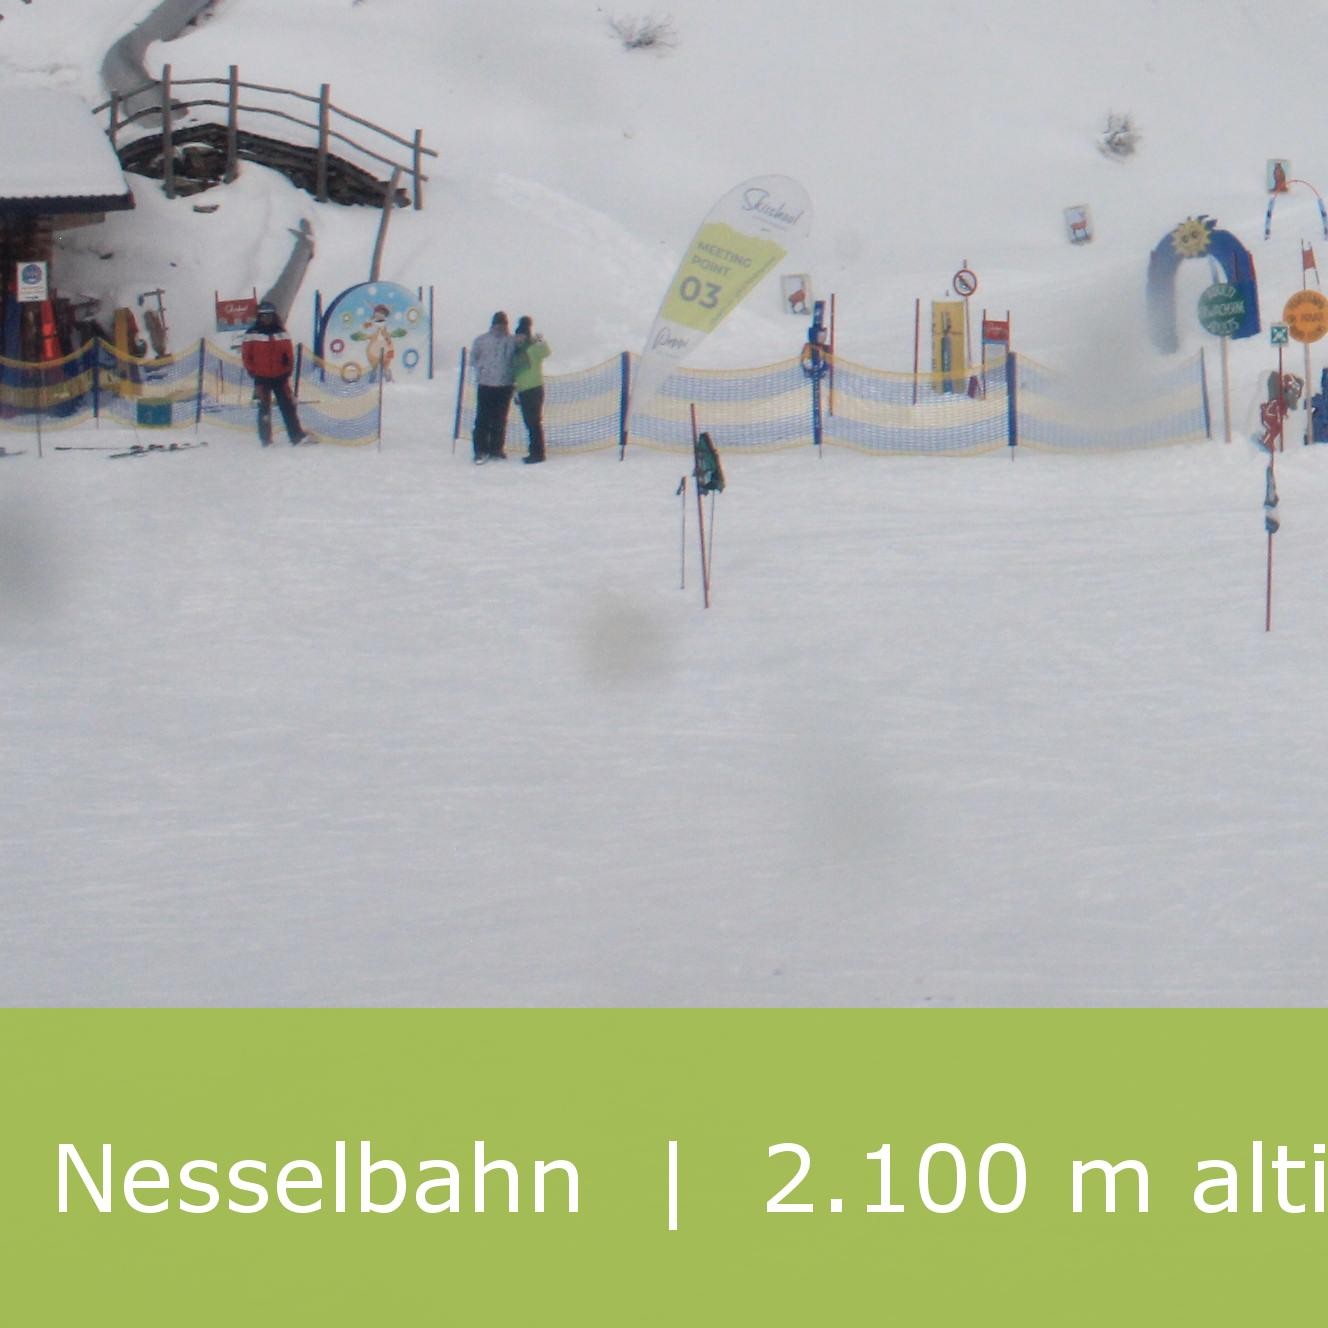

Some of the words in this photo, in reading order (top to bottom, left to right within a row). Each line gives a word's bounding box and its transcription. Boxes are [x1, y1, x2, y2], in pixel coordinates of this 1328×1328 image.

[692, 254, 731, 276] POINT
[697, 241, 752, 268] MEETING
[679, 275, 722, 309] 03
